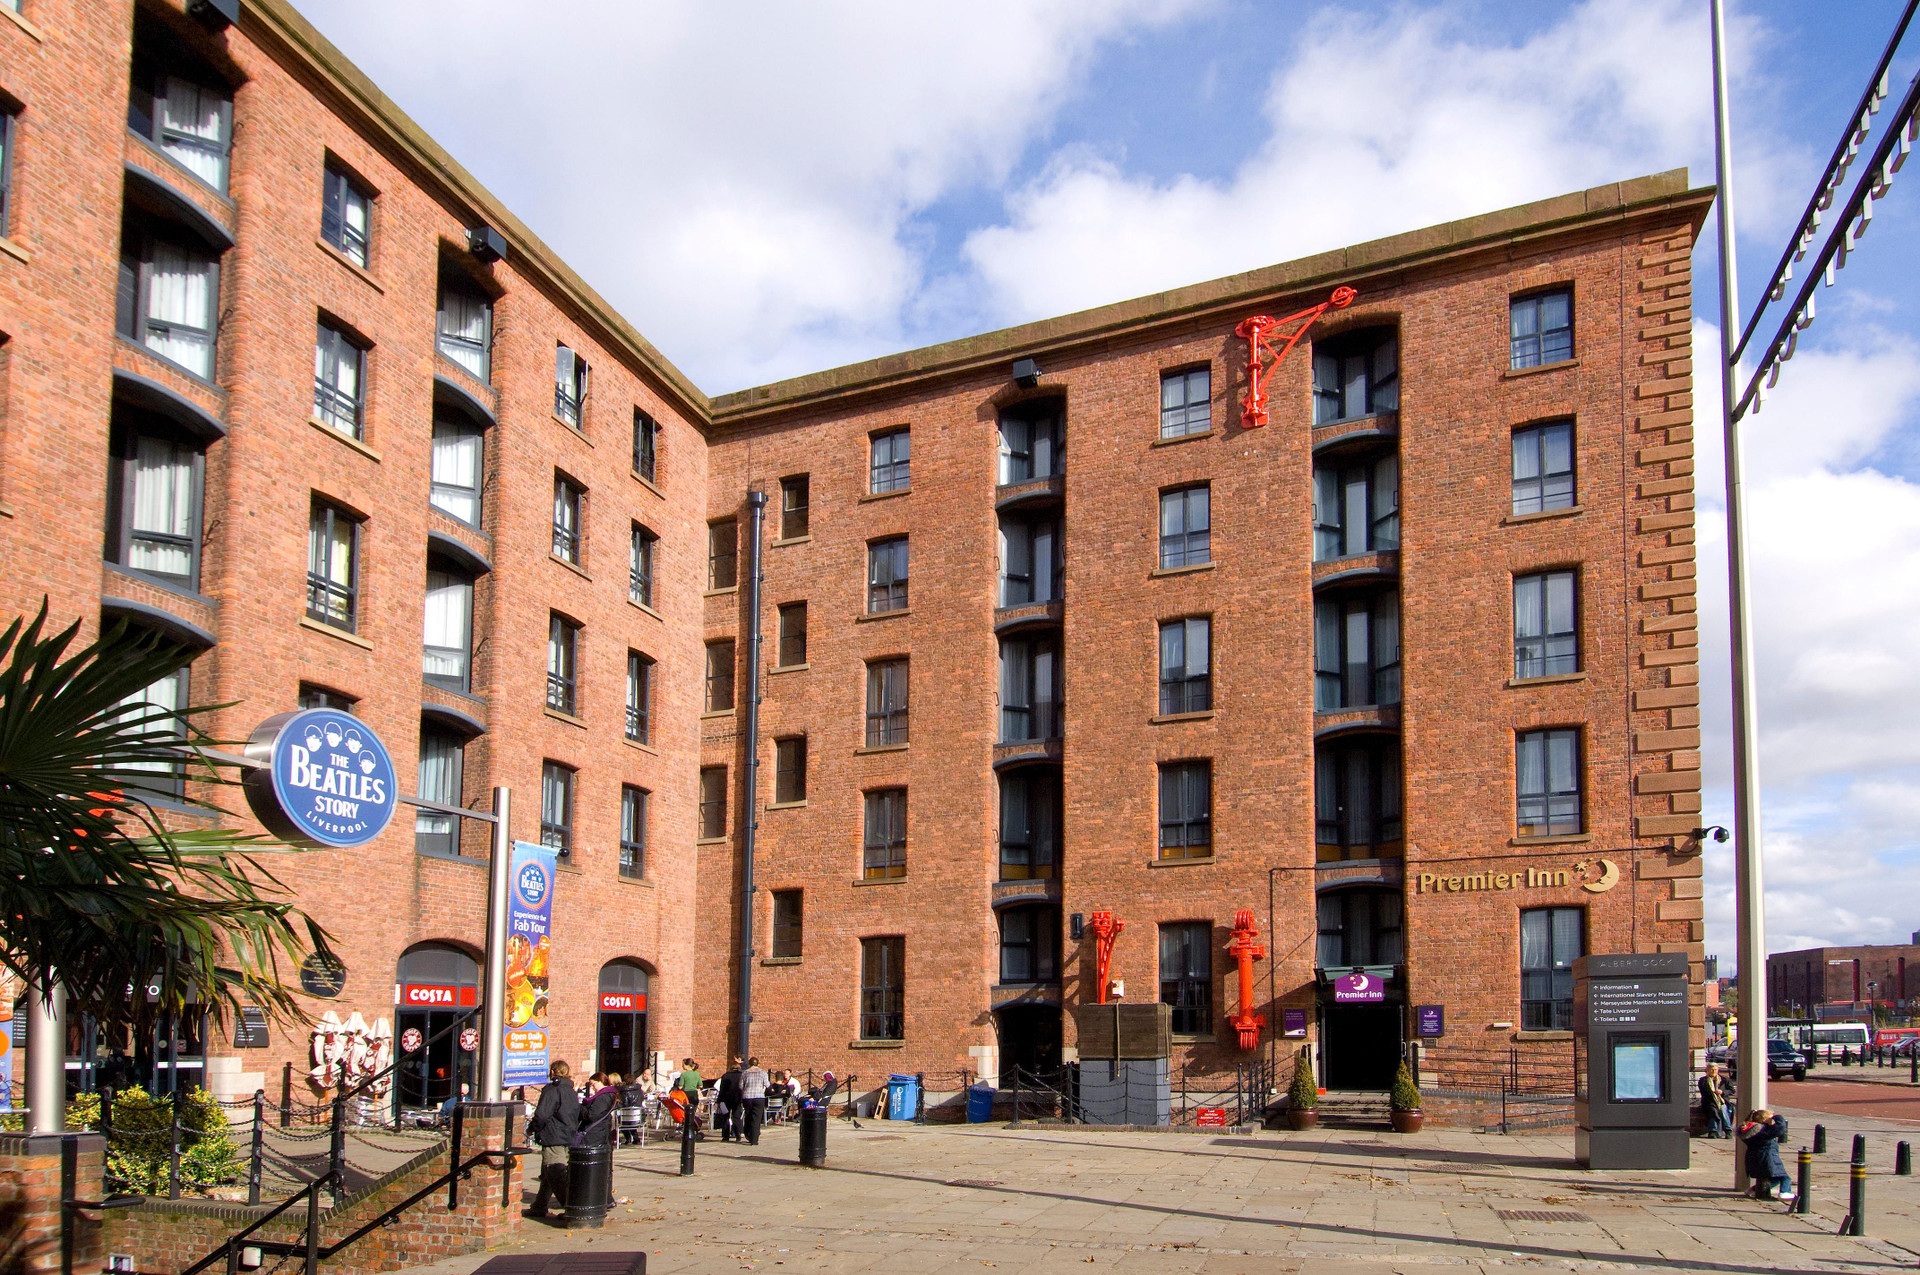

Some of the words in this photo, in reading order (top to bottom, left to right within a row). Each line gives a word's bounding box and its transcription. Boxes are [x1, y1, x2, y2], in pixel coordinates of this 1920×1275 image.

[330, 753, 350, 769] THE
[290, 744, 386, 805] BEATLES
[315, 795, 359, 819] STORY
[306, 810, 368, 834] LIVERPOOL
[1420, 870, 1523, 893] Premier
[1528, 868, 1568, 887] Inn
[514, 911, 540, 921] Experience
[514, 920, 529, 931] Fab
[530, 922, 546, 933] Tour
[410, 989, 452, 1003] COSTA
[604, 997, 631, 1008] COSTA
[511, 1032, 527, 1042] Open
[528, 1032, 543, 1042] Daily
[530, 1042, 543, 1051] 7pm
